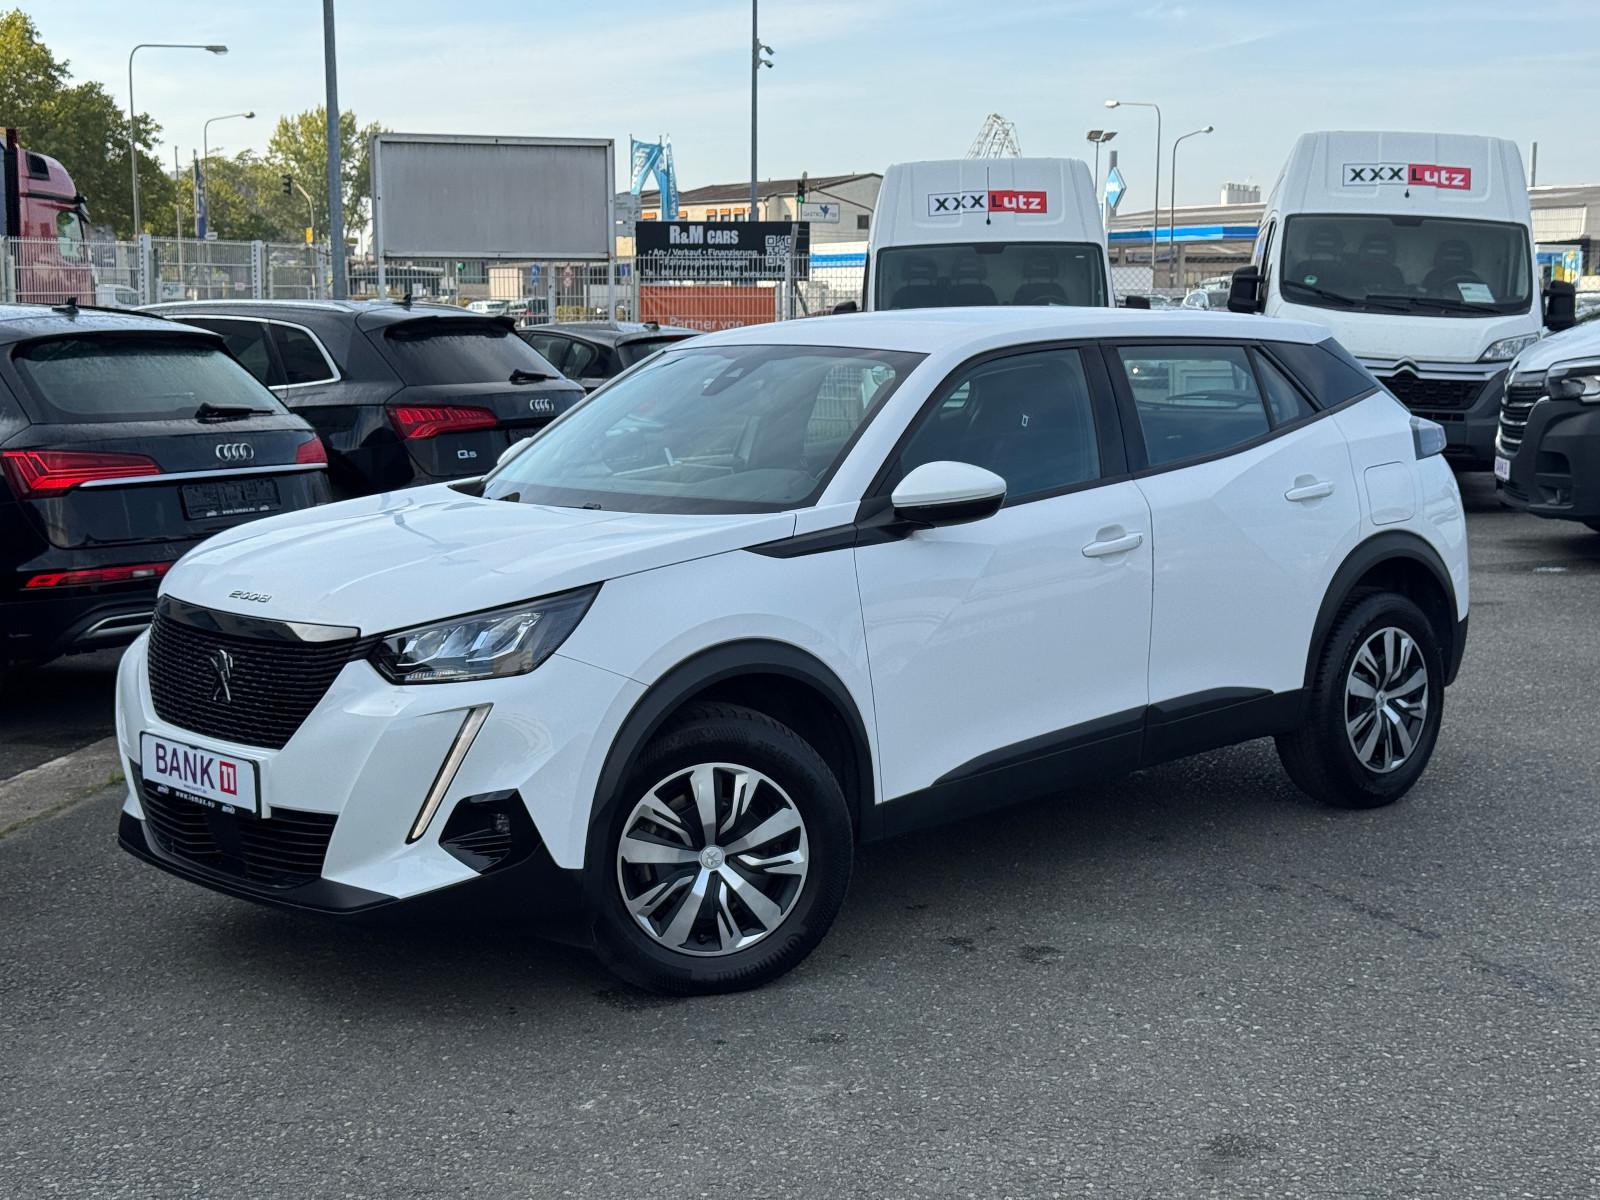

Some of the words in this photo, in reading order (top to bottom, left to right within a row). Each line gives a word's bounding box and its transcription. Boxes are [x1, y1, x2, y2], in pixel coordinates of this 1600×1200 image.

[669, 225, 704, 245] R&M
[707, 230, 739, 245] CARS
[672, 248, 702, 256] Verkauf
[669, 314, 717, 329] Partner
[457, 450, 477, 459] Q5
[228, 590, 272, 603] 2008
[155, 742, 216, 790] BANK
[221, 764, 235, 792] 11
